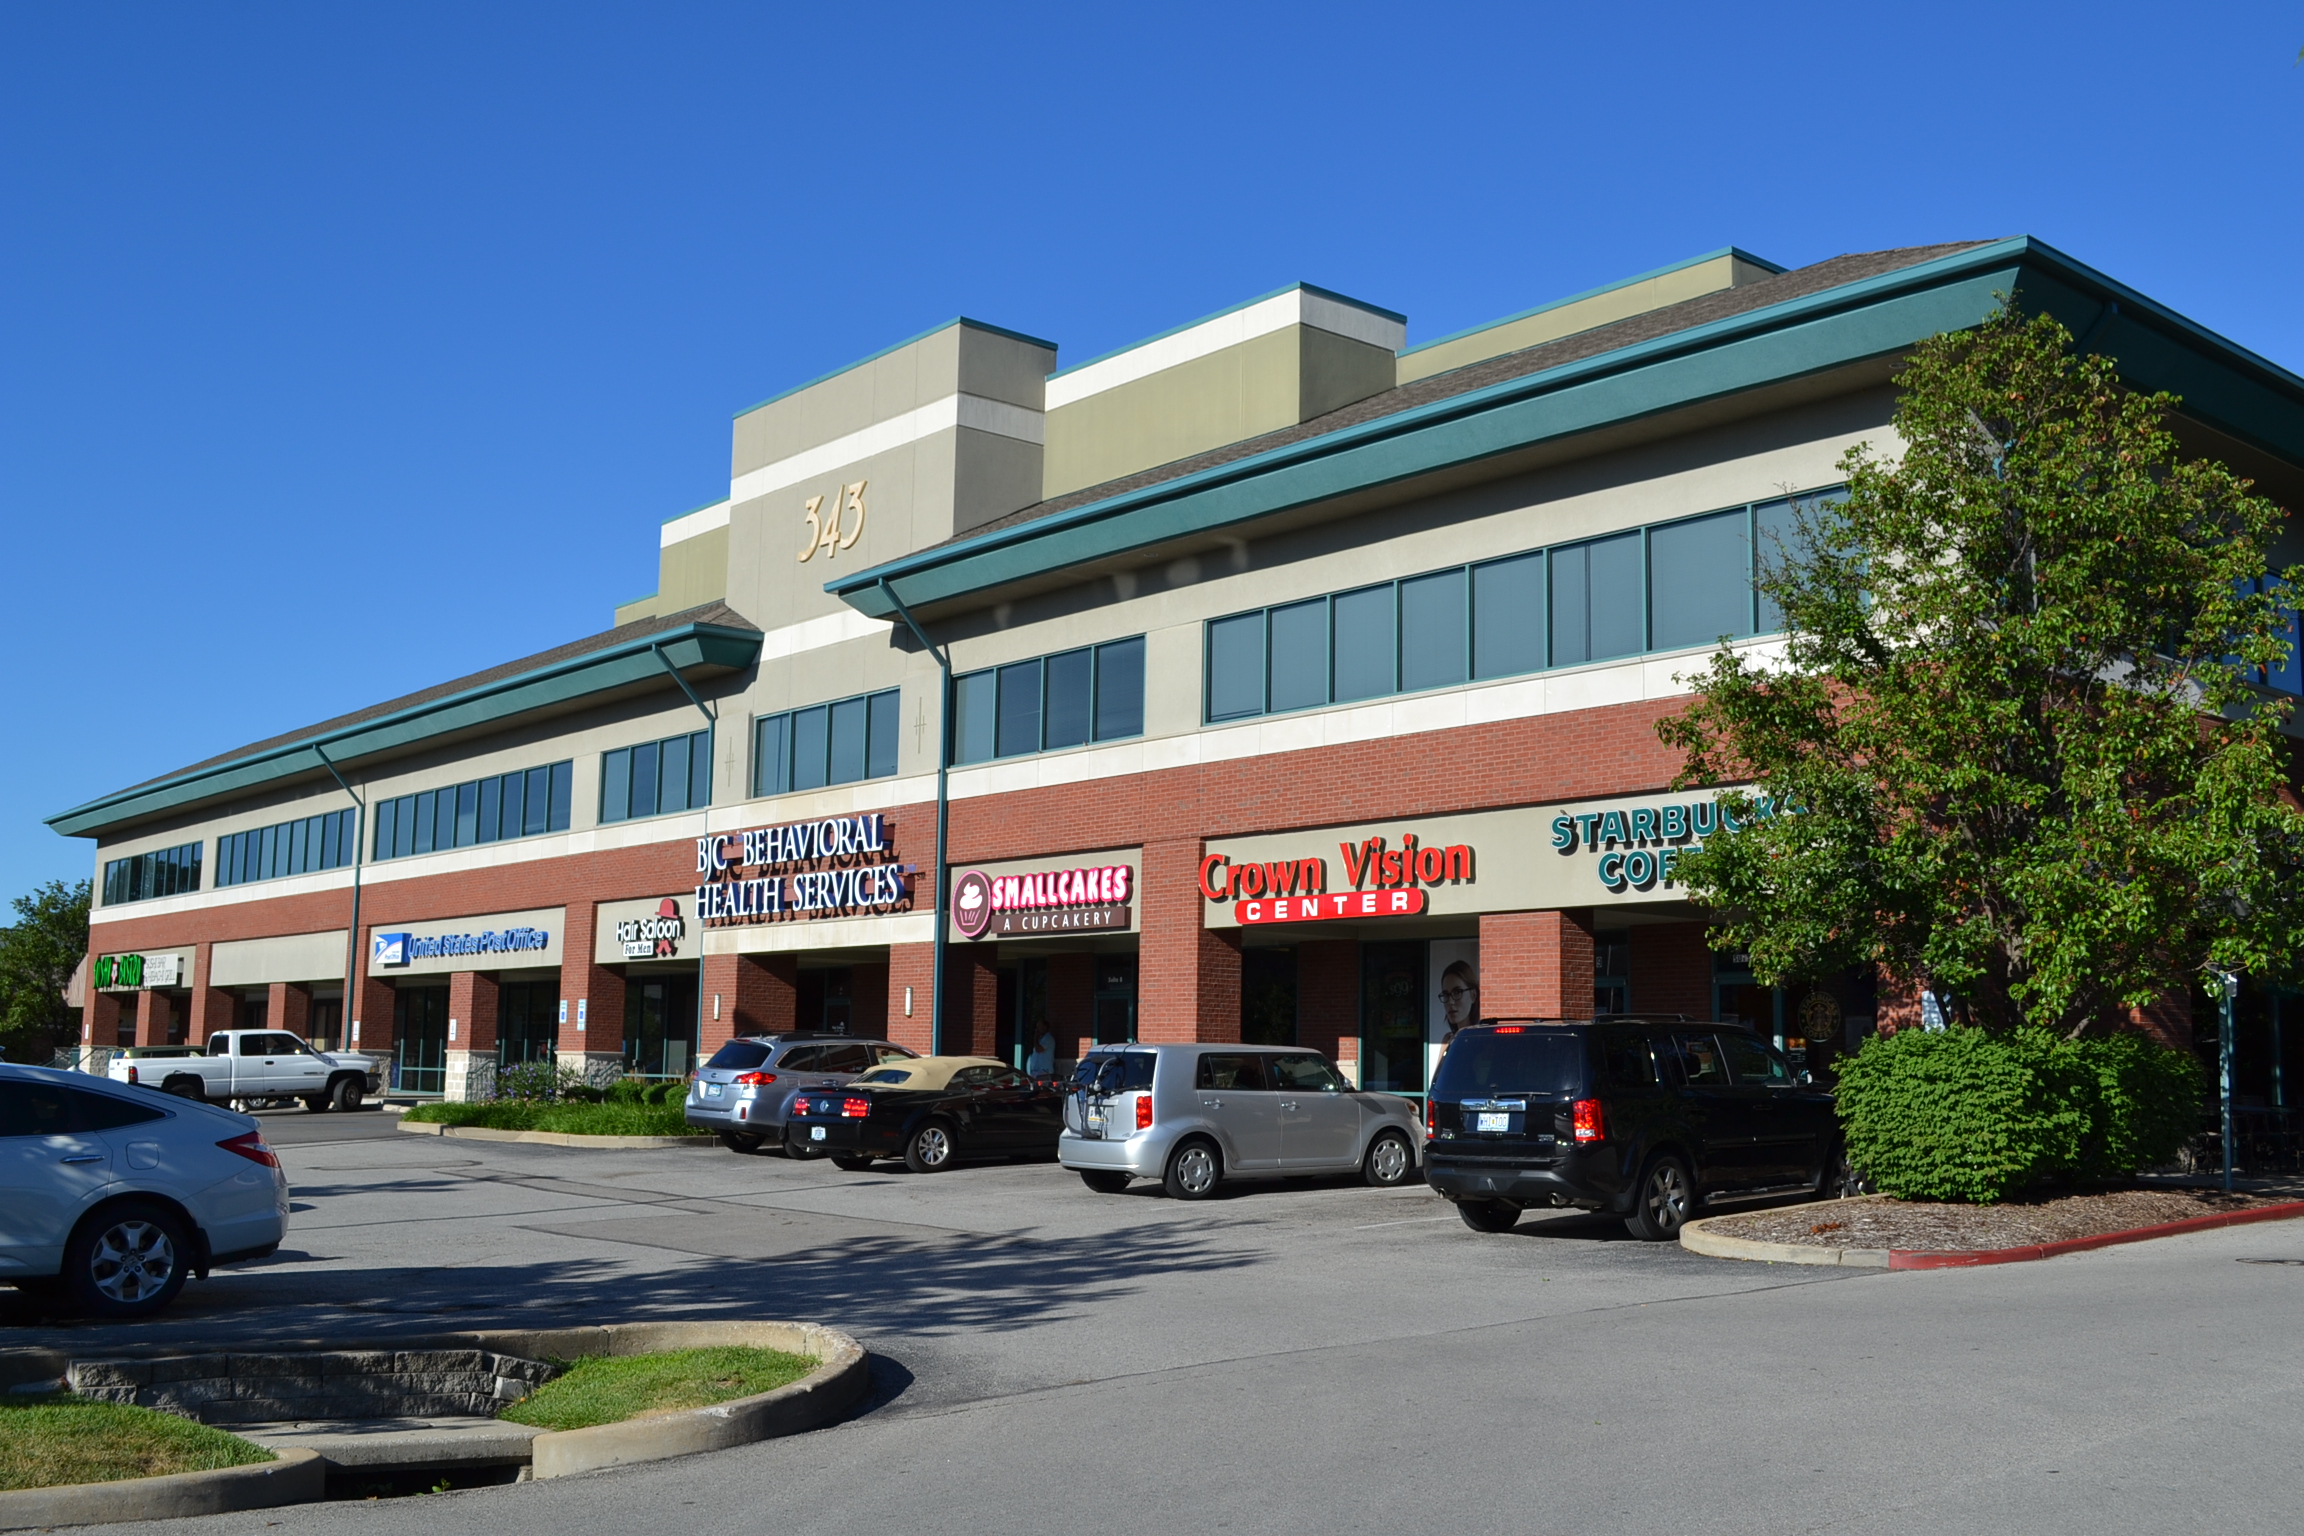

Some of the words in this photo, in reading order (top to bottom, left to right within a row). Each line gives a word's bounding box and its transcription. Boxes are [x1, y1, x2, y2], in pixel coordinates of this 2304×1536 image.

[797, 480, 868, 563] 343
[696, 835, 728, 881] BJC
[742, 813, 884, 867] BEHAVIORAL
[1199, 853, 1322, 899] Crown
[1339, 833, 1471, 886] Vision
[1597, 845, 1704, 887] COF
[694, 877, 782, 919] HEALTH
[793, 864, 898, 911] SERVICES
[991, 865, 1128, 910] SMALLCAKES
[1246, 891, 1409, 921] CENTER
[616, 919, 639, 942] Hair
[640, 917, 681, 940] Saloon
[1003, 917, 1011, 931] A
[1021, 910, 1112, 930] CUPCAKERY
[408, 935, 443, 958] United
[443, 934, 479, 955] States
[480, 930, 507, 951] Post
[507, 927, 544, 949] Office
[625, 944, 635, 954] For
[637, 943, 652, 954] Men
